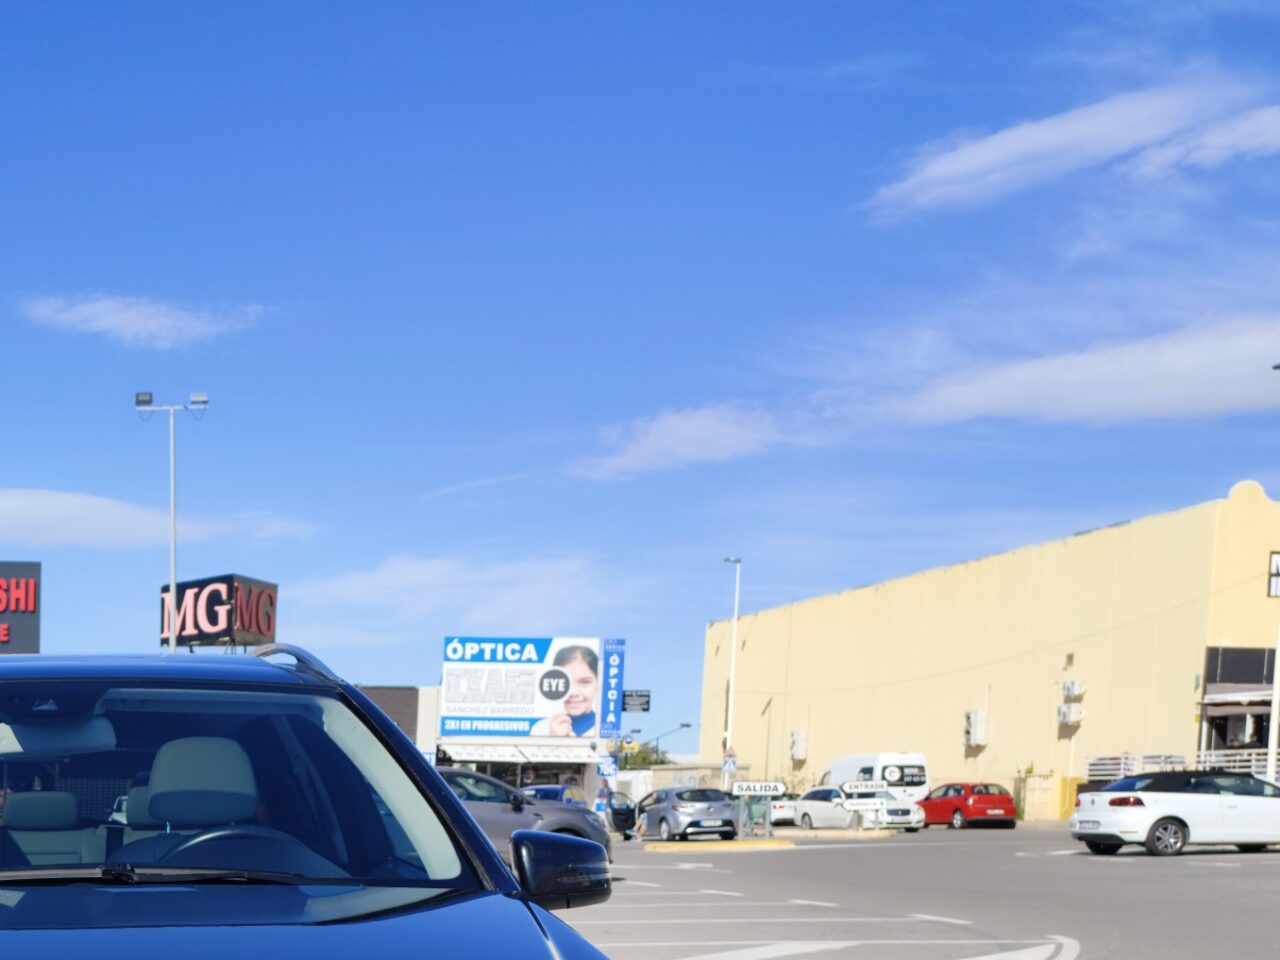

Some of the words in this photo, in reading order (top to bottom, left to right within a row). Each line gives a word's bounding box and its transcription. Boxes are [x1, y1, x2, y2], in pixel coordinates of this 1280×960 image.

[160, 582, 231, 638] MG
[233, 581, 275, 637] MG
[446, 637, 539, 661] ÓPTICA
[542, 678, 566, 692] EYE
[736, 784, 780, 793] SALIDA
[848, 783, 885, 791] ENTRADA
